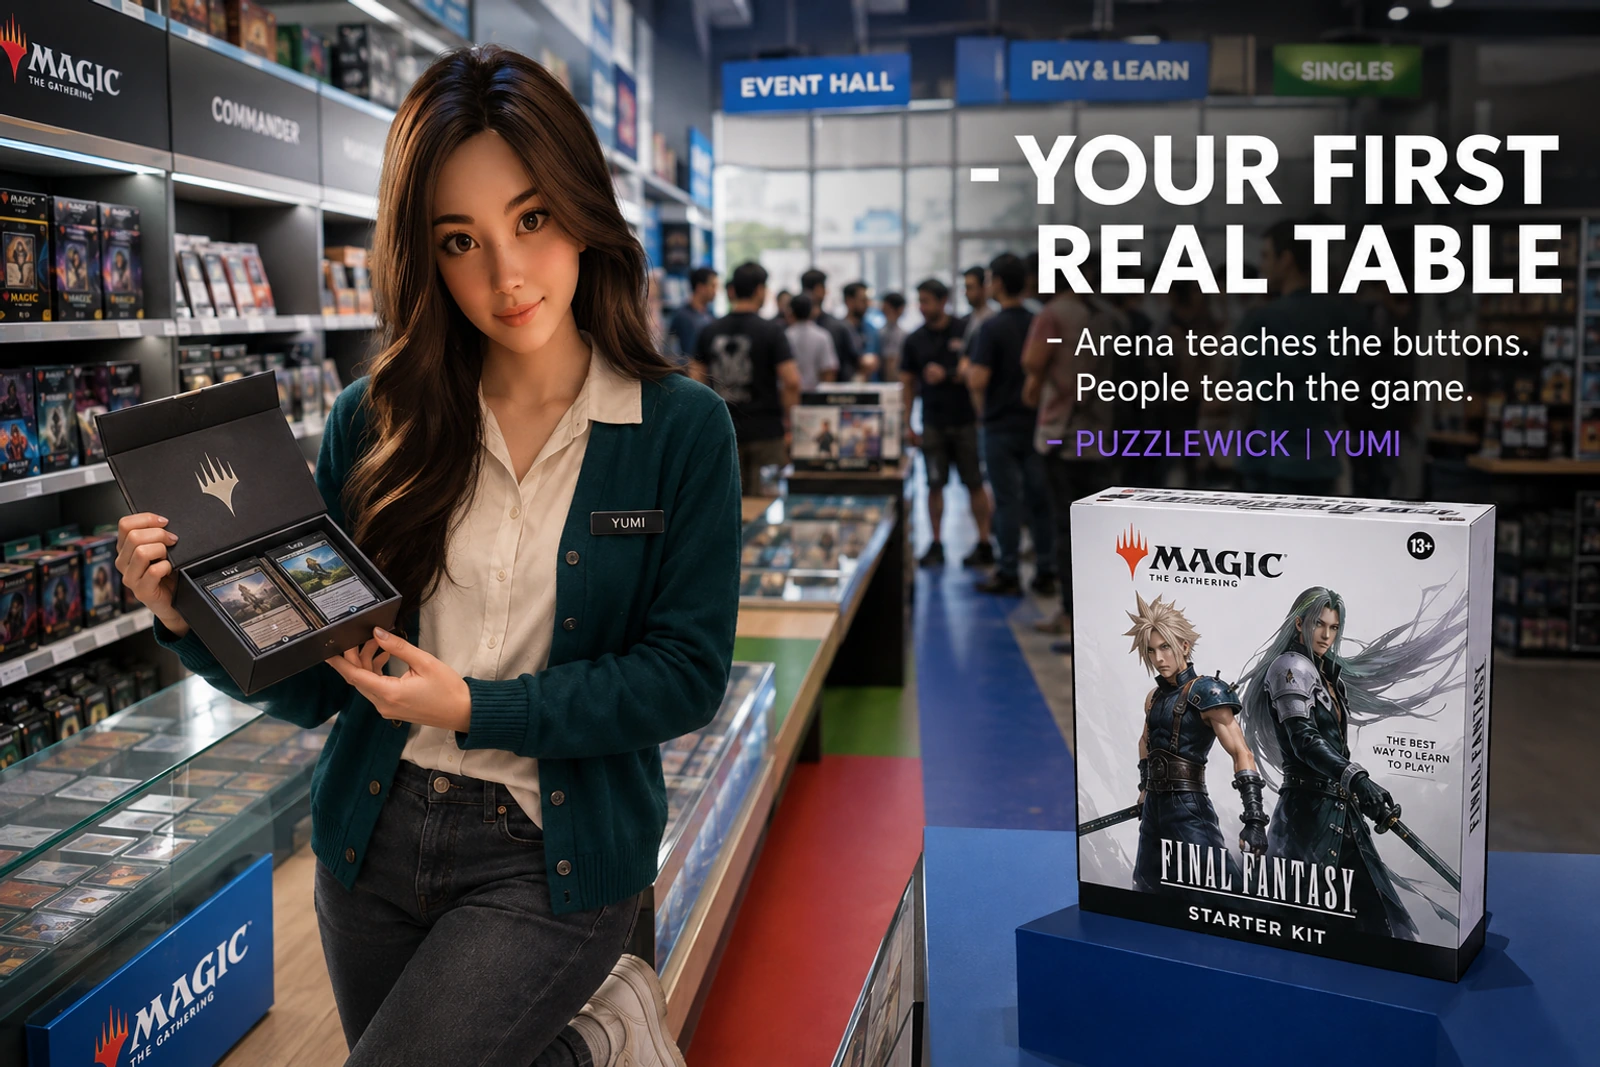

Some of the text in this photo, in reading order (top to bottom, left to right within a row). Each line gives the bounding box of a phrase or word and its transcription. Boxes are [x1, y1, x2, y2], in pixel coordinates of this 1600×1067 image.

[28, 42, 120, 96] MAGIC
[1031, 60, 1190, 81] PLAY & LEARN
[1301, 61, 1395, 81] SINGLES
[28, 75, 94, 102] THE GATHERING
[740, 71, 895, 98] EVENT HALL
[211, 96, 300, 145] COMMANDER
[10, 292, 39, 303] MAGIC
[611, 517, 645, 529] YUMI
[1410, 538, 1433, 554] 13+
[1148, 545, 1284, 580] MAGIC
[1149, 573, 1239, 588] THE GATHERING
[1372, 746, 1450, 764] WAY TO LEARN
[1386, 735, 1436, 750] THE BEST
[1469, 662, 1486, 838] FINAL FANTASY
[1388, 759, 1435, 774] TO PLAY!
[1160, 838, 1355, 913] FINAL FANTASY
[1188, 906, 1326, 945] STARTER KIT
[129, 924, 249, 1055] MAGIC
[129, 990, 215, 1067] THE GATHERING
